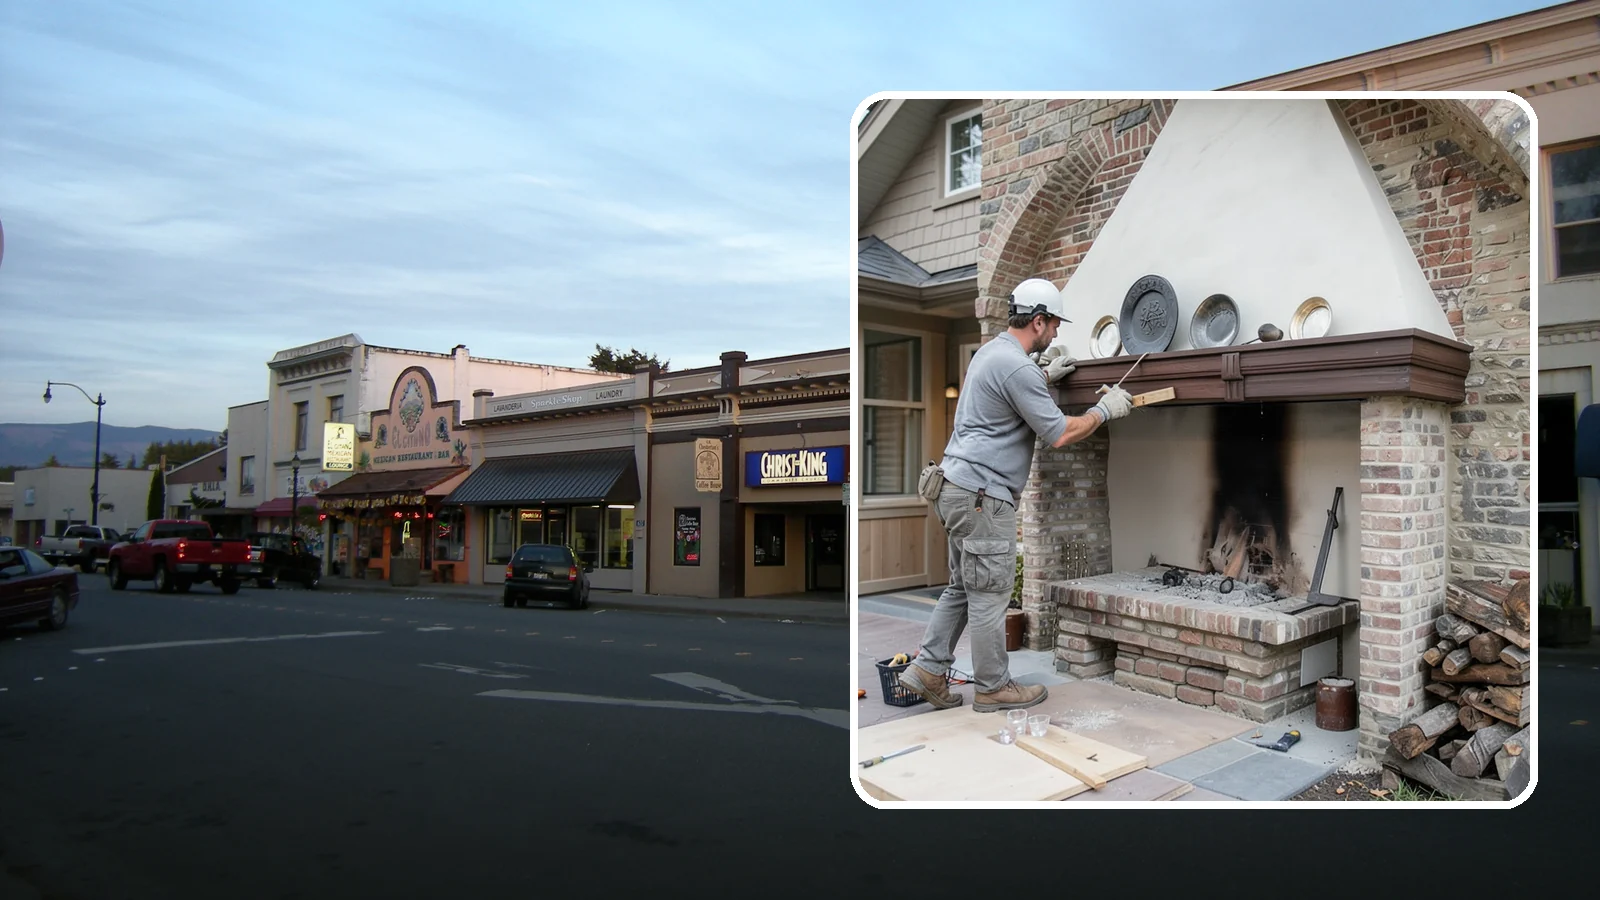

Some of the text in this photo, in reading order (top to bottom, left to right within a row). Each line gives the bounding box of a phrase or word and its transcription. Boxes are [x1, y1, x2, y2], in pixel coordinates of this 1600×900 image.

[493, 402, 522, 412] LAVANDERIA
[562, 394, 582, 405] Shop
[595, 389, 624, 399] LAUNDRY
[373, 455, 396, 464] MEXICAN
[397, 451, 433, 463] RESTAURANT
[437, 450, 450, 459] BAR
[761, 449, 827, 477] CHRIST KING
[696, 480, 721, 489] Coffee House
